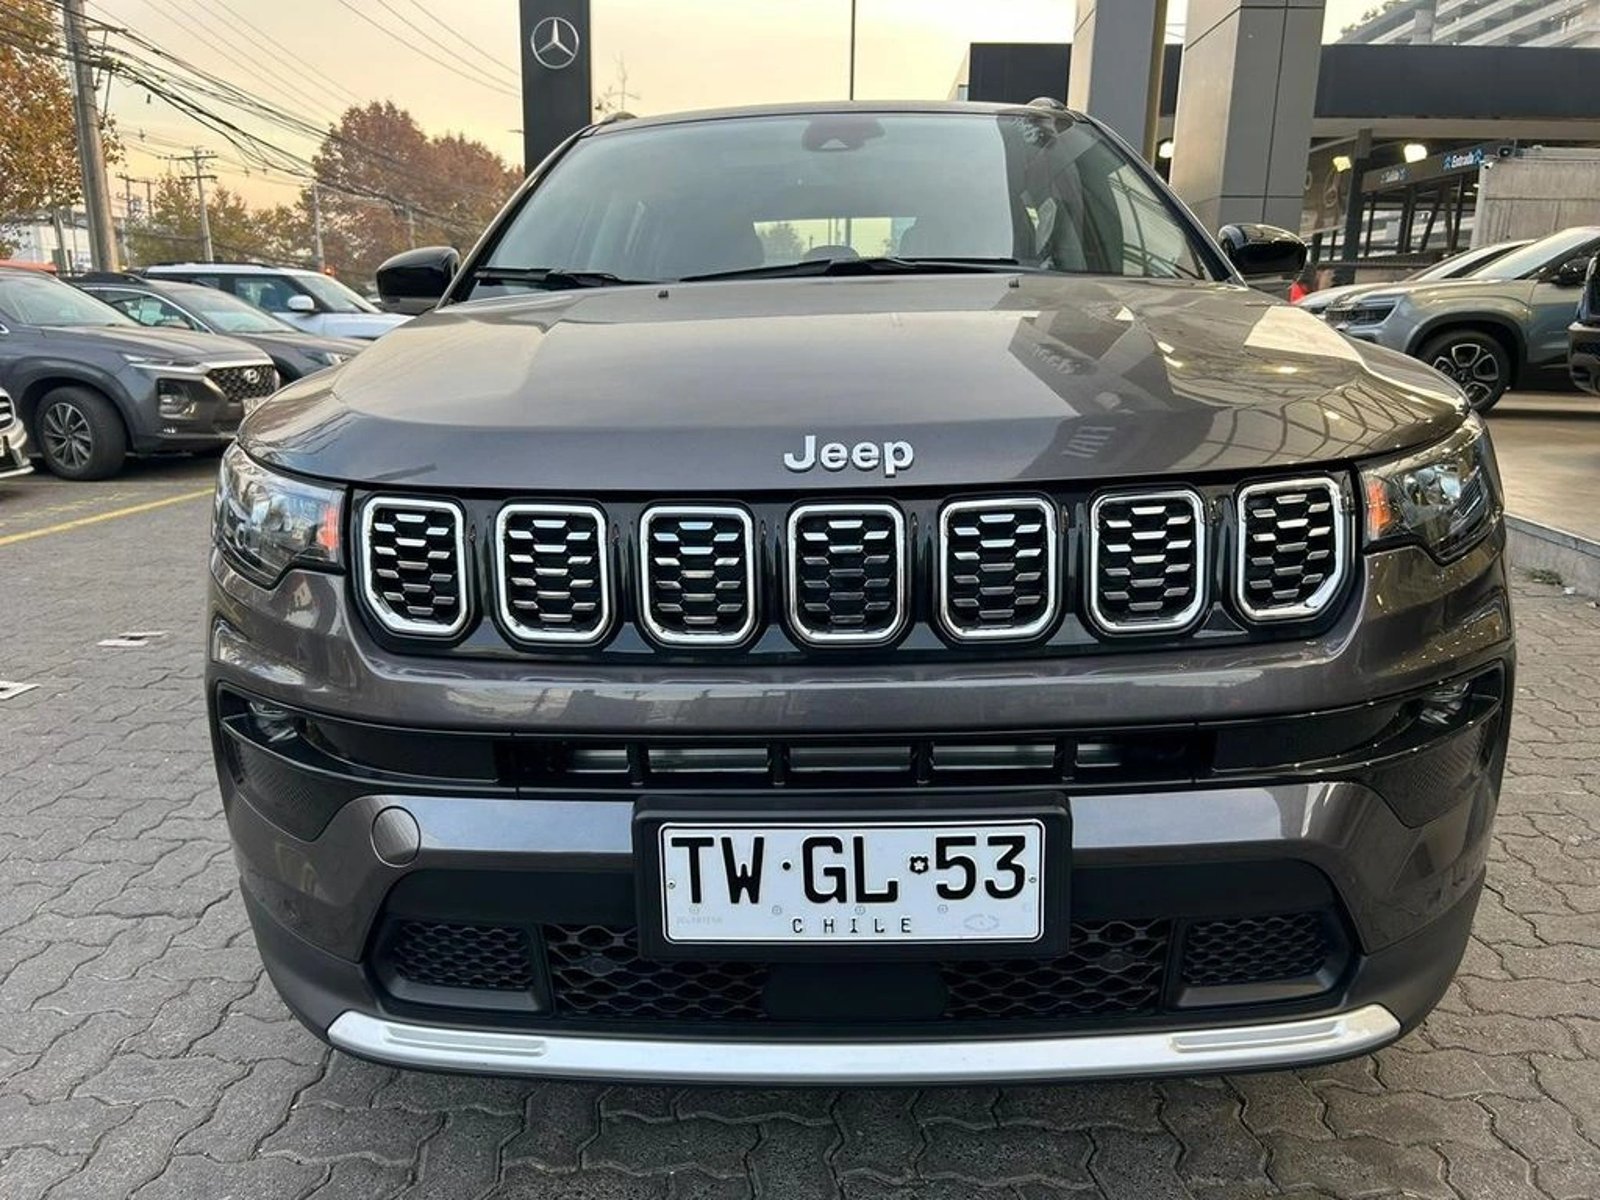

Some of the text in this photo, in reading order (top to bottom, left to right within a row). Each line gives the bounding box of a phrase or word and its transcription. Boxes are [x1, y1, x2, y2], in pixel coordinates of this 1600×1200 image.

[784, 434, 914, 477] Jeep
[935, 834, 1027, 900] 53
[792, 918, 912, 935] CHILE
